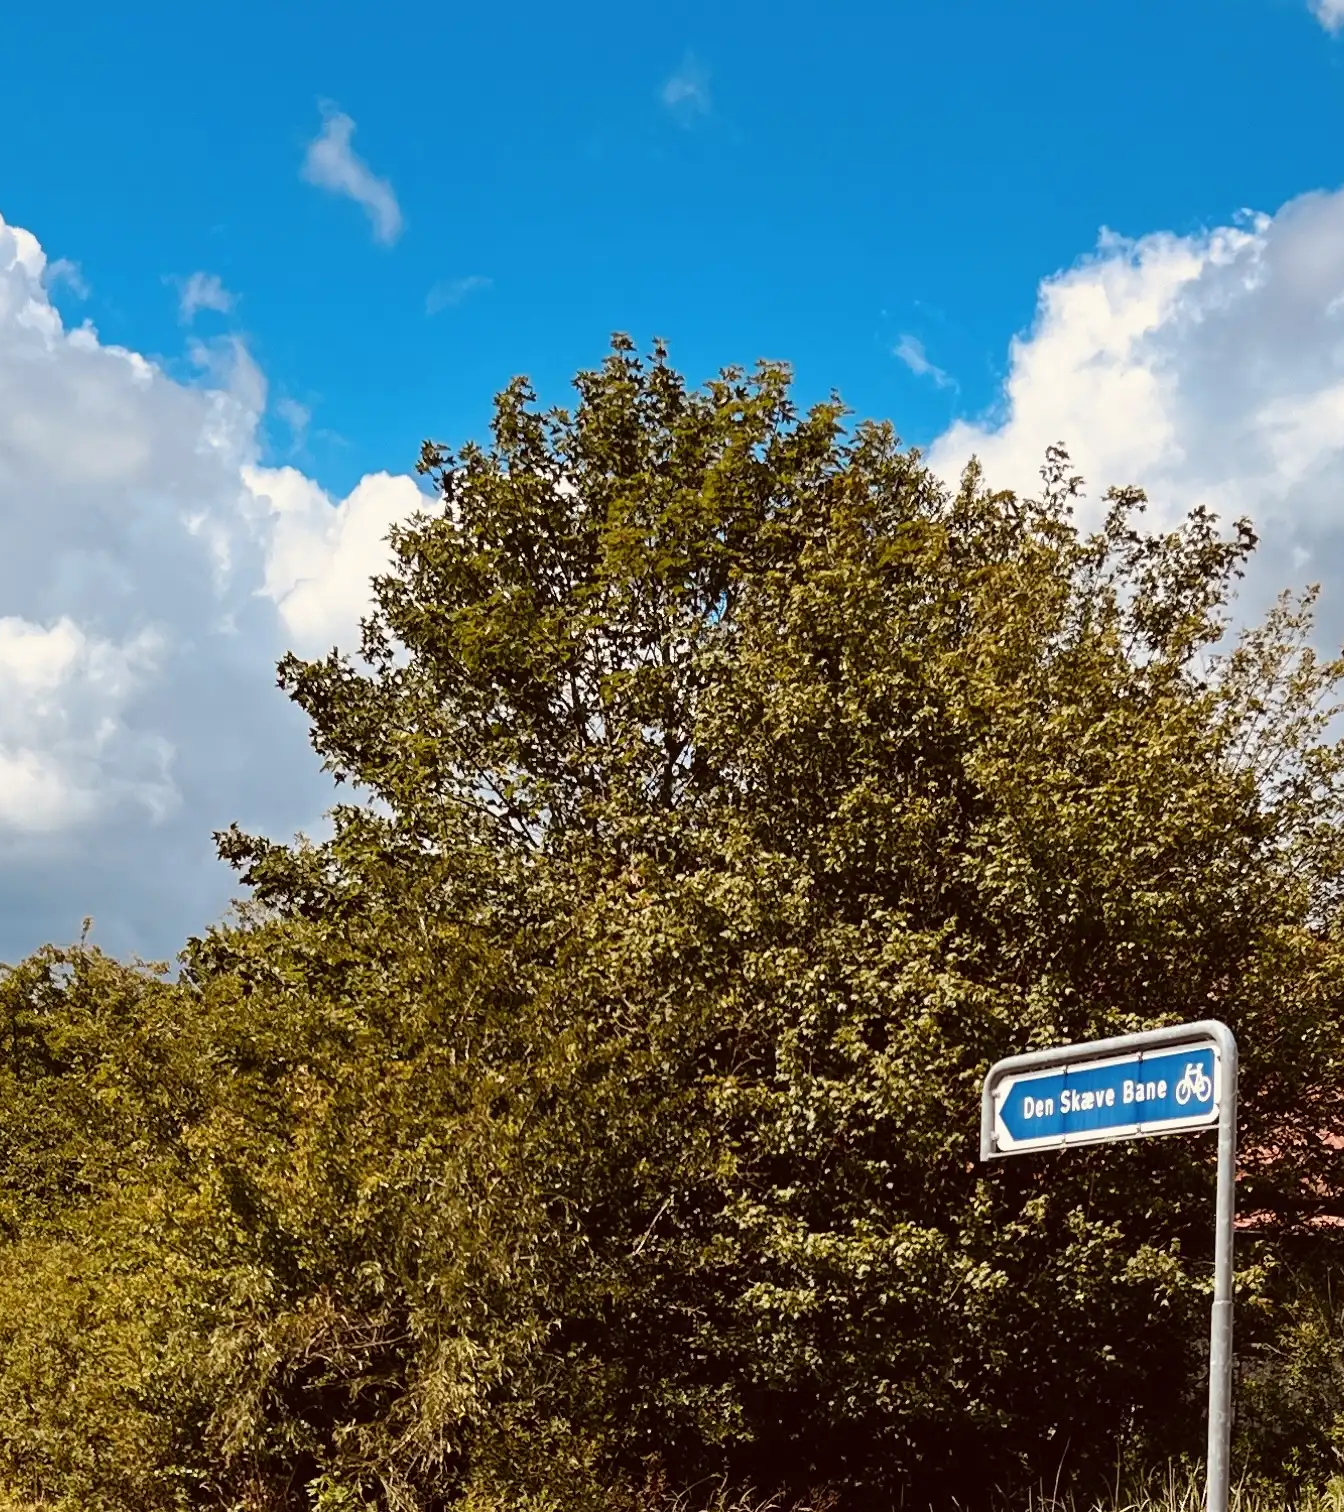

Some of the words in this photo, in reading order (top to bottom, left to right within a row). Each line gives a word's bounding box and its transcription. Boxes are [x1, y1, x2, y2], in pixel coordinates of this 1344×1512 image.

[1024, 1096, 1053, 1119] Den
[1060, 1087, 1115, 1114] Skæve
[1122, 1079, 1167, 1104] Bane
